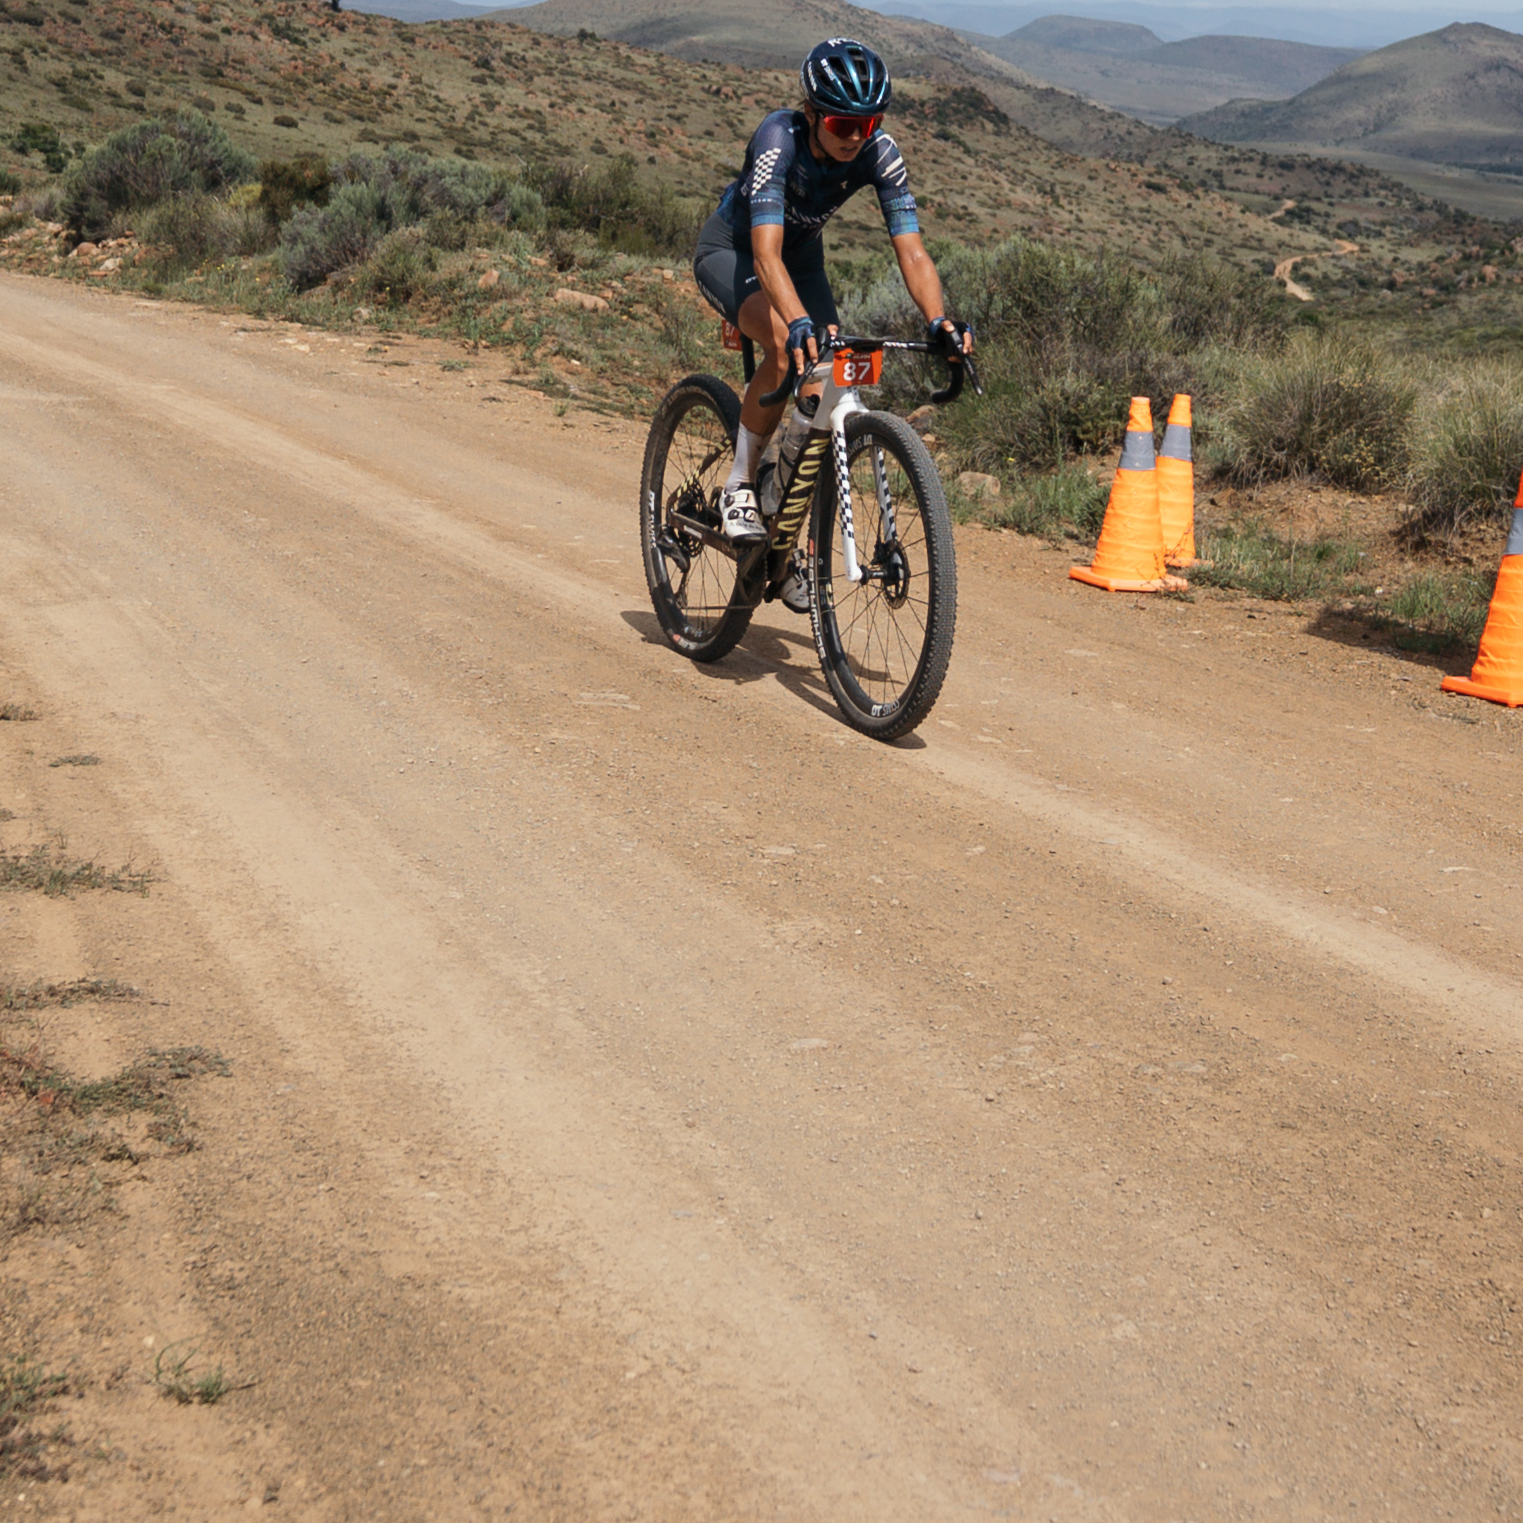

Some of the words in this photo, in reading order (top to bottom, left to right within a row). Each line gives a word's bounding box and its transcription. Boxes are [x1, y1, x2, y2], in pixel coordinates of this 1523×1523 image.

[843, 361, 871, 381] 87
[771, 437, 830, 550] CANYON
[808, 556, 827, 659] SCHWALBE
